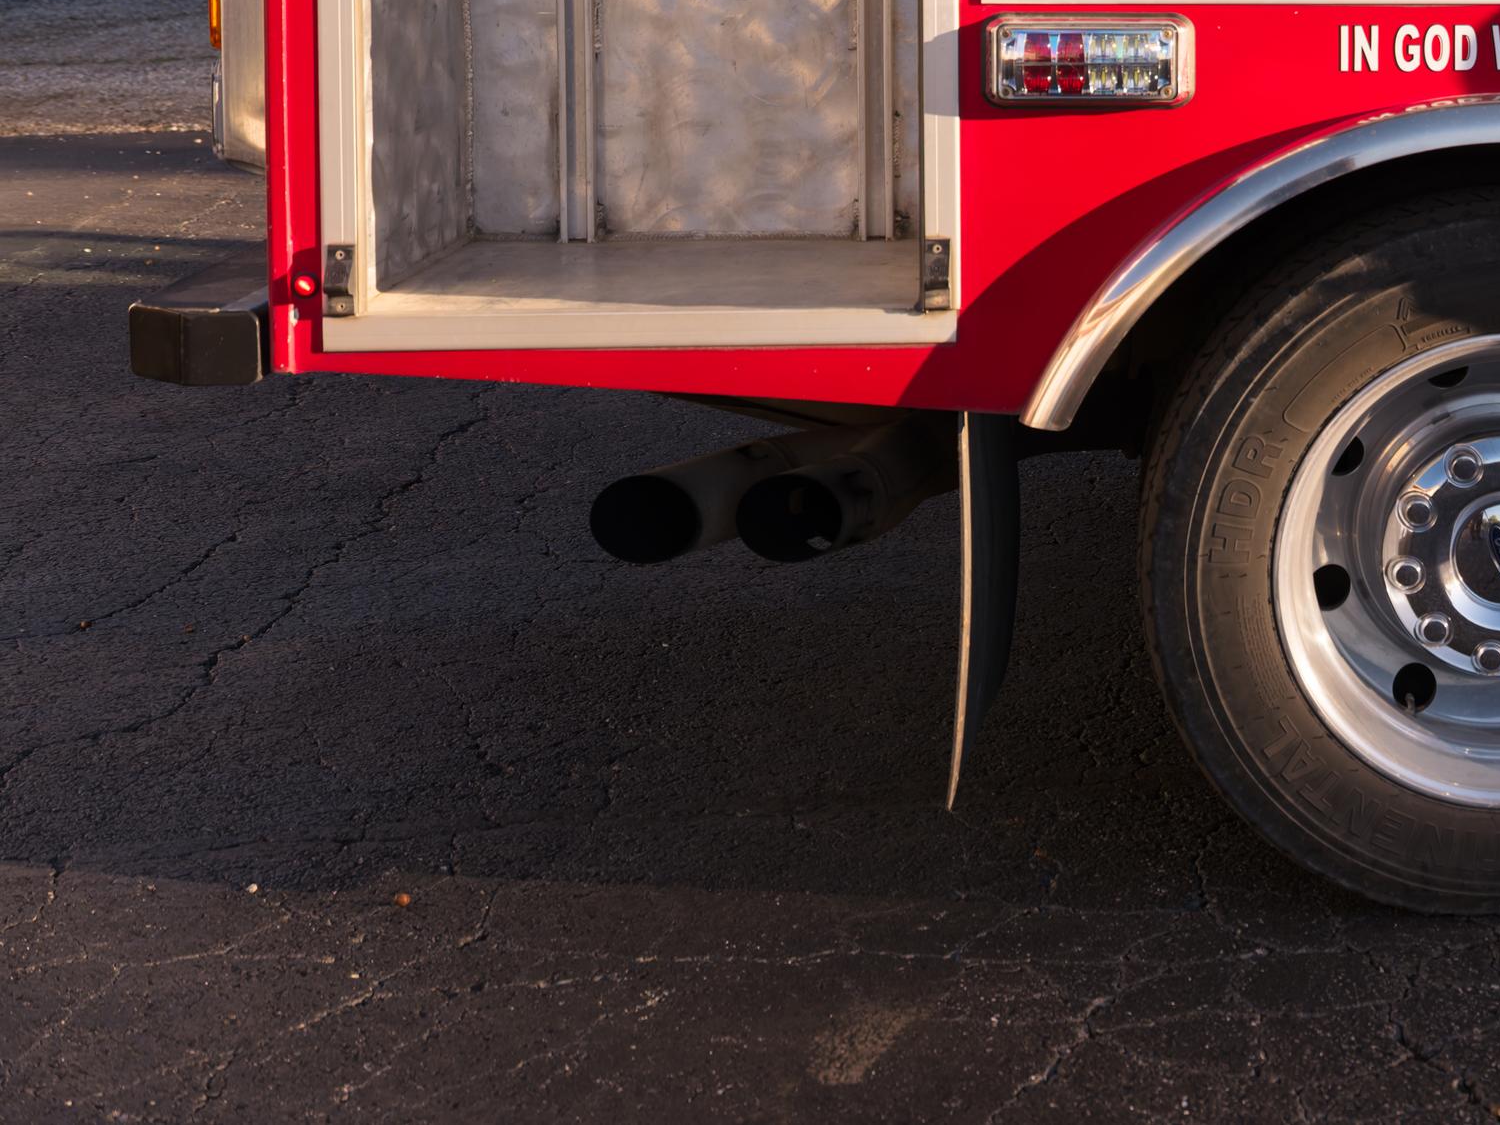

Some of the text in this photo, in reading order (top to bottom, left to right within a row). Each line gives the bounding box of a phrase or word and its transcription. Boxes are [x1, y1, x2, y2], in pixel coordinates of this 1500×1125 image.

[1339, 25, 1379, 72] IN
[1394, 24, 1478, 72] GOD
[1209, 434, 1284, 564] HDR
